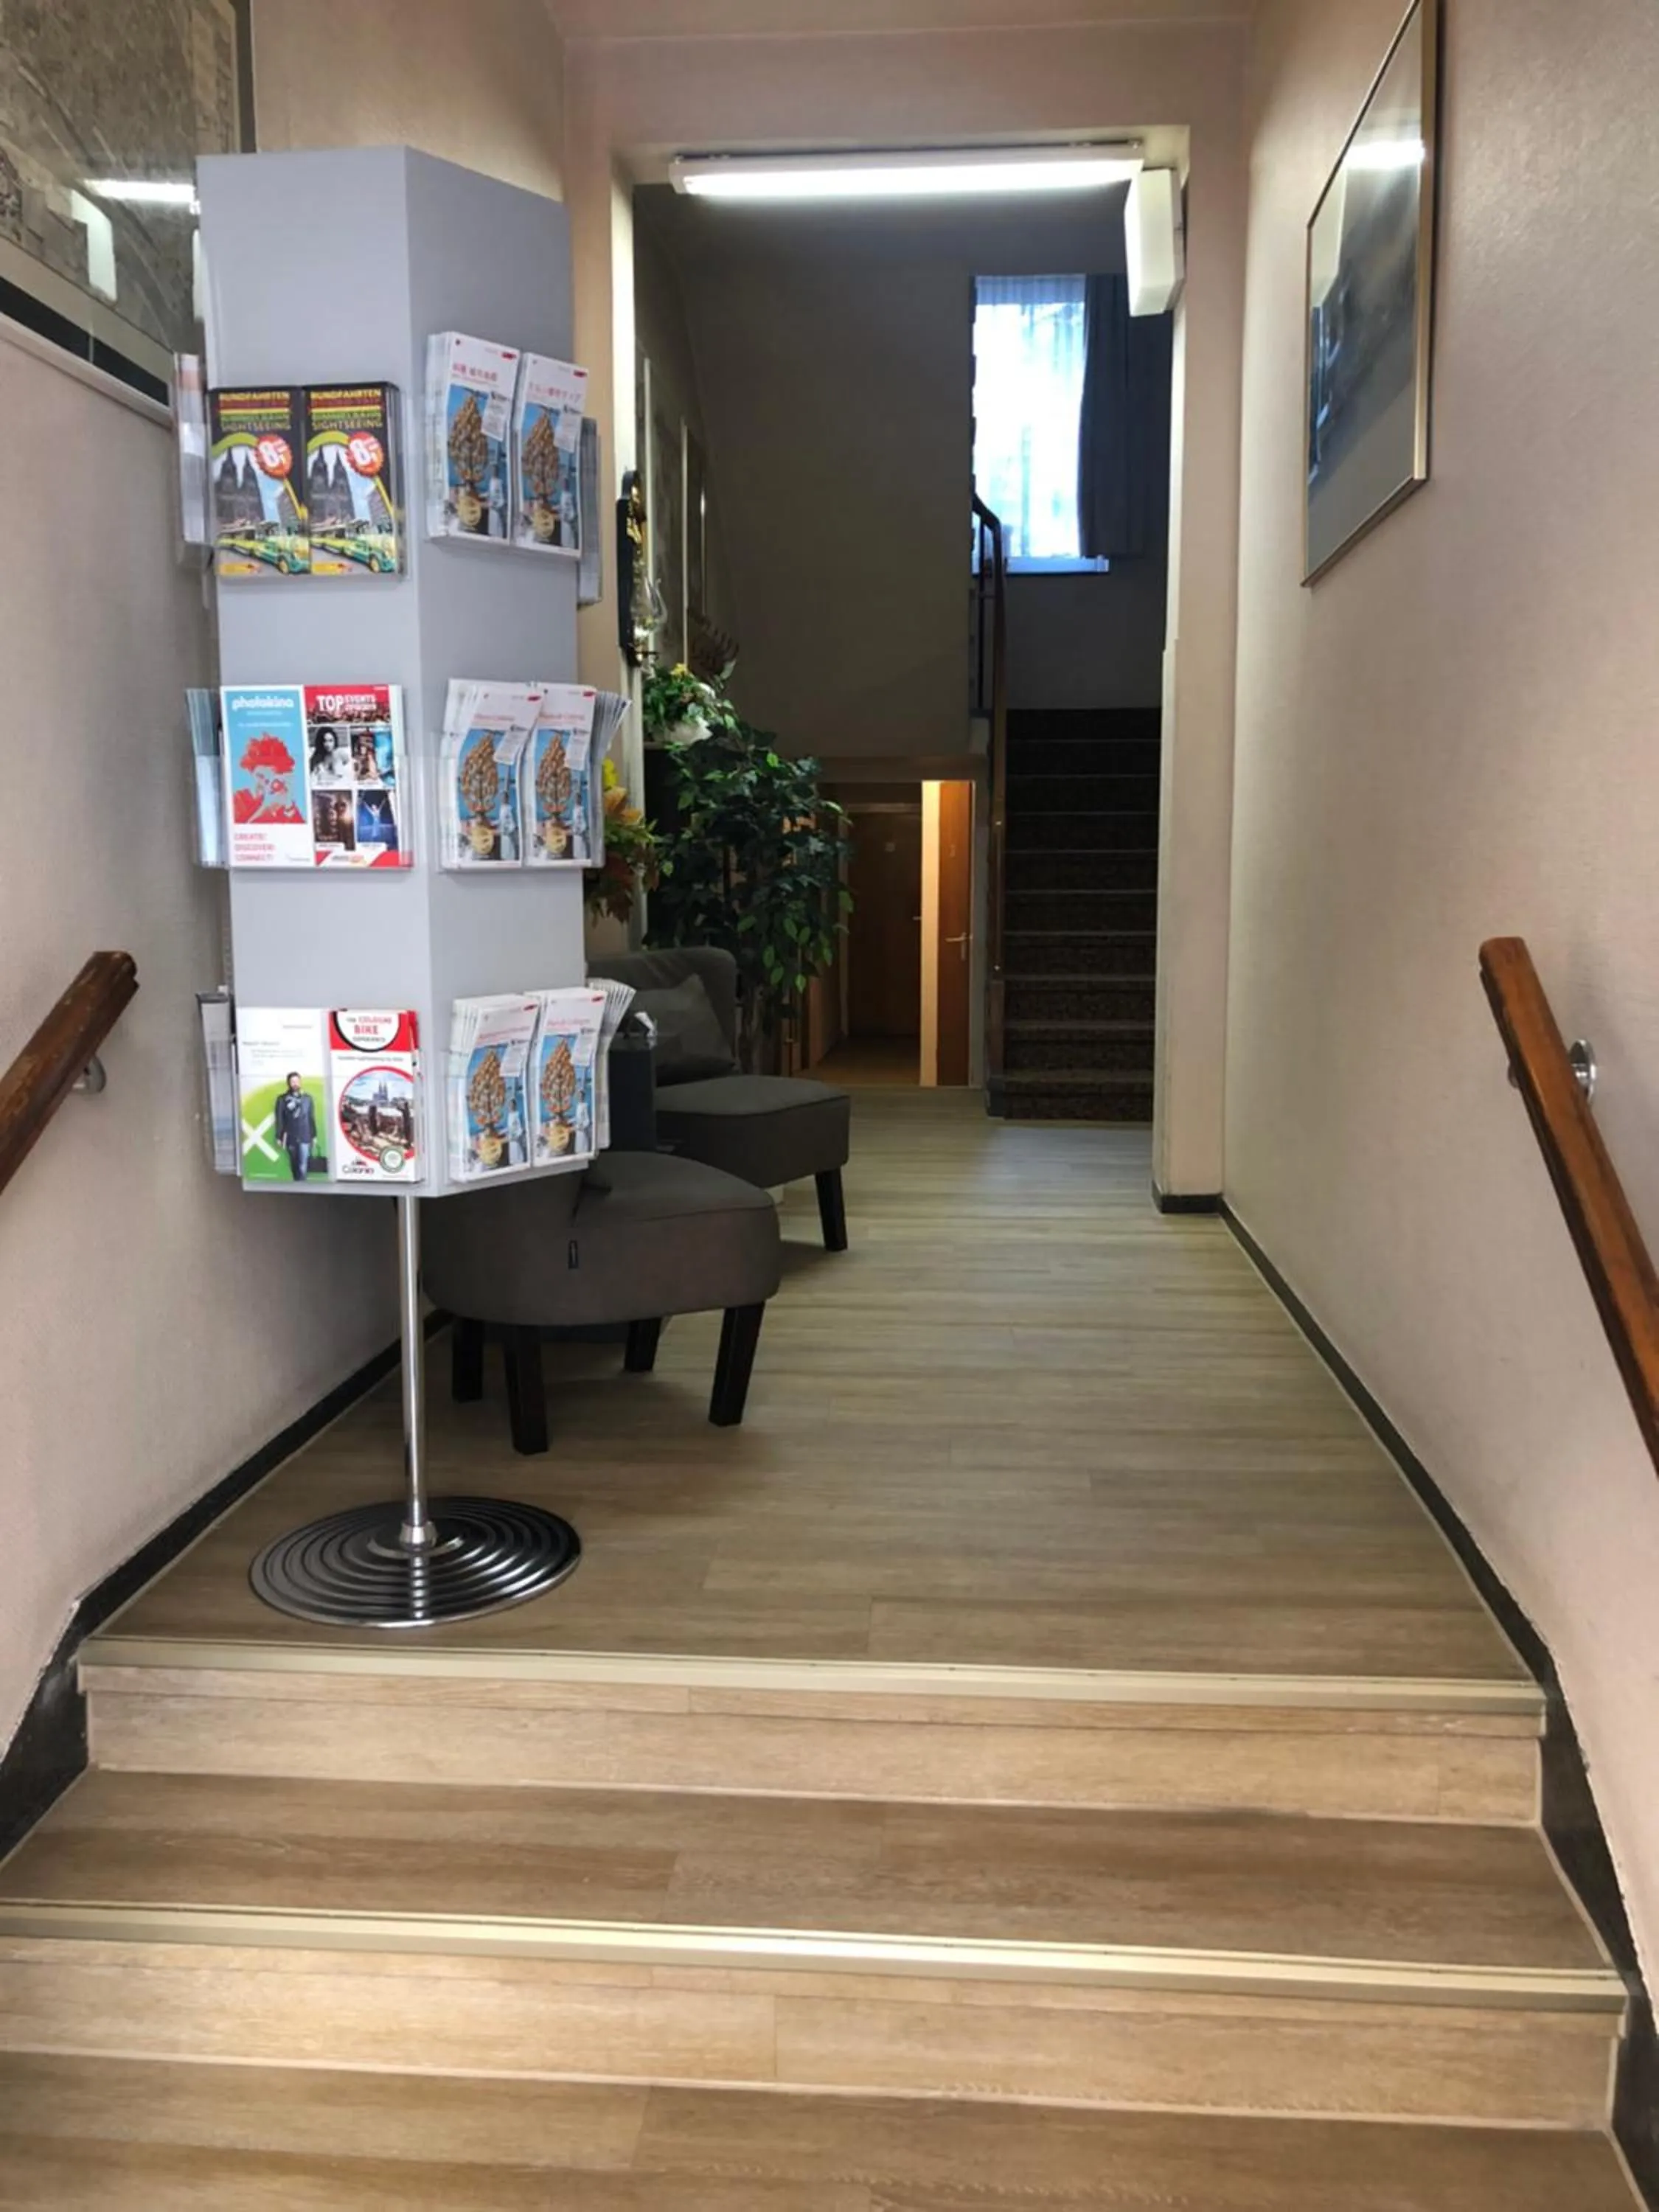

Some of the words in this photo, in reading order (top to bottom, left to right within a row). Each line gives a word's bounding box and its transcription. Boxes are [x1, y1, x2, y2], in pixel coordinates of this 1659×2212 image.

[221, 421, 291, 432] SIGHTSEEING
[312, 418, 383, 431] SIGHTSEEING
[232, 695, 294, 712] photokina
[316, 694, 344, 712] TOP
[353, 1023, 378, 1035] BIKE
